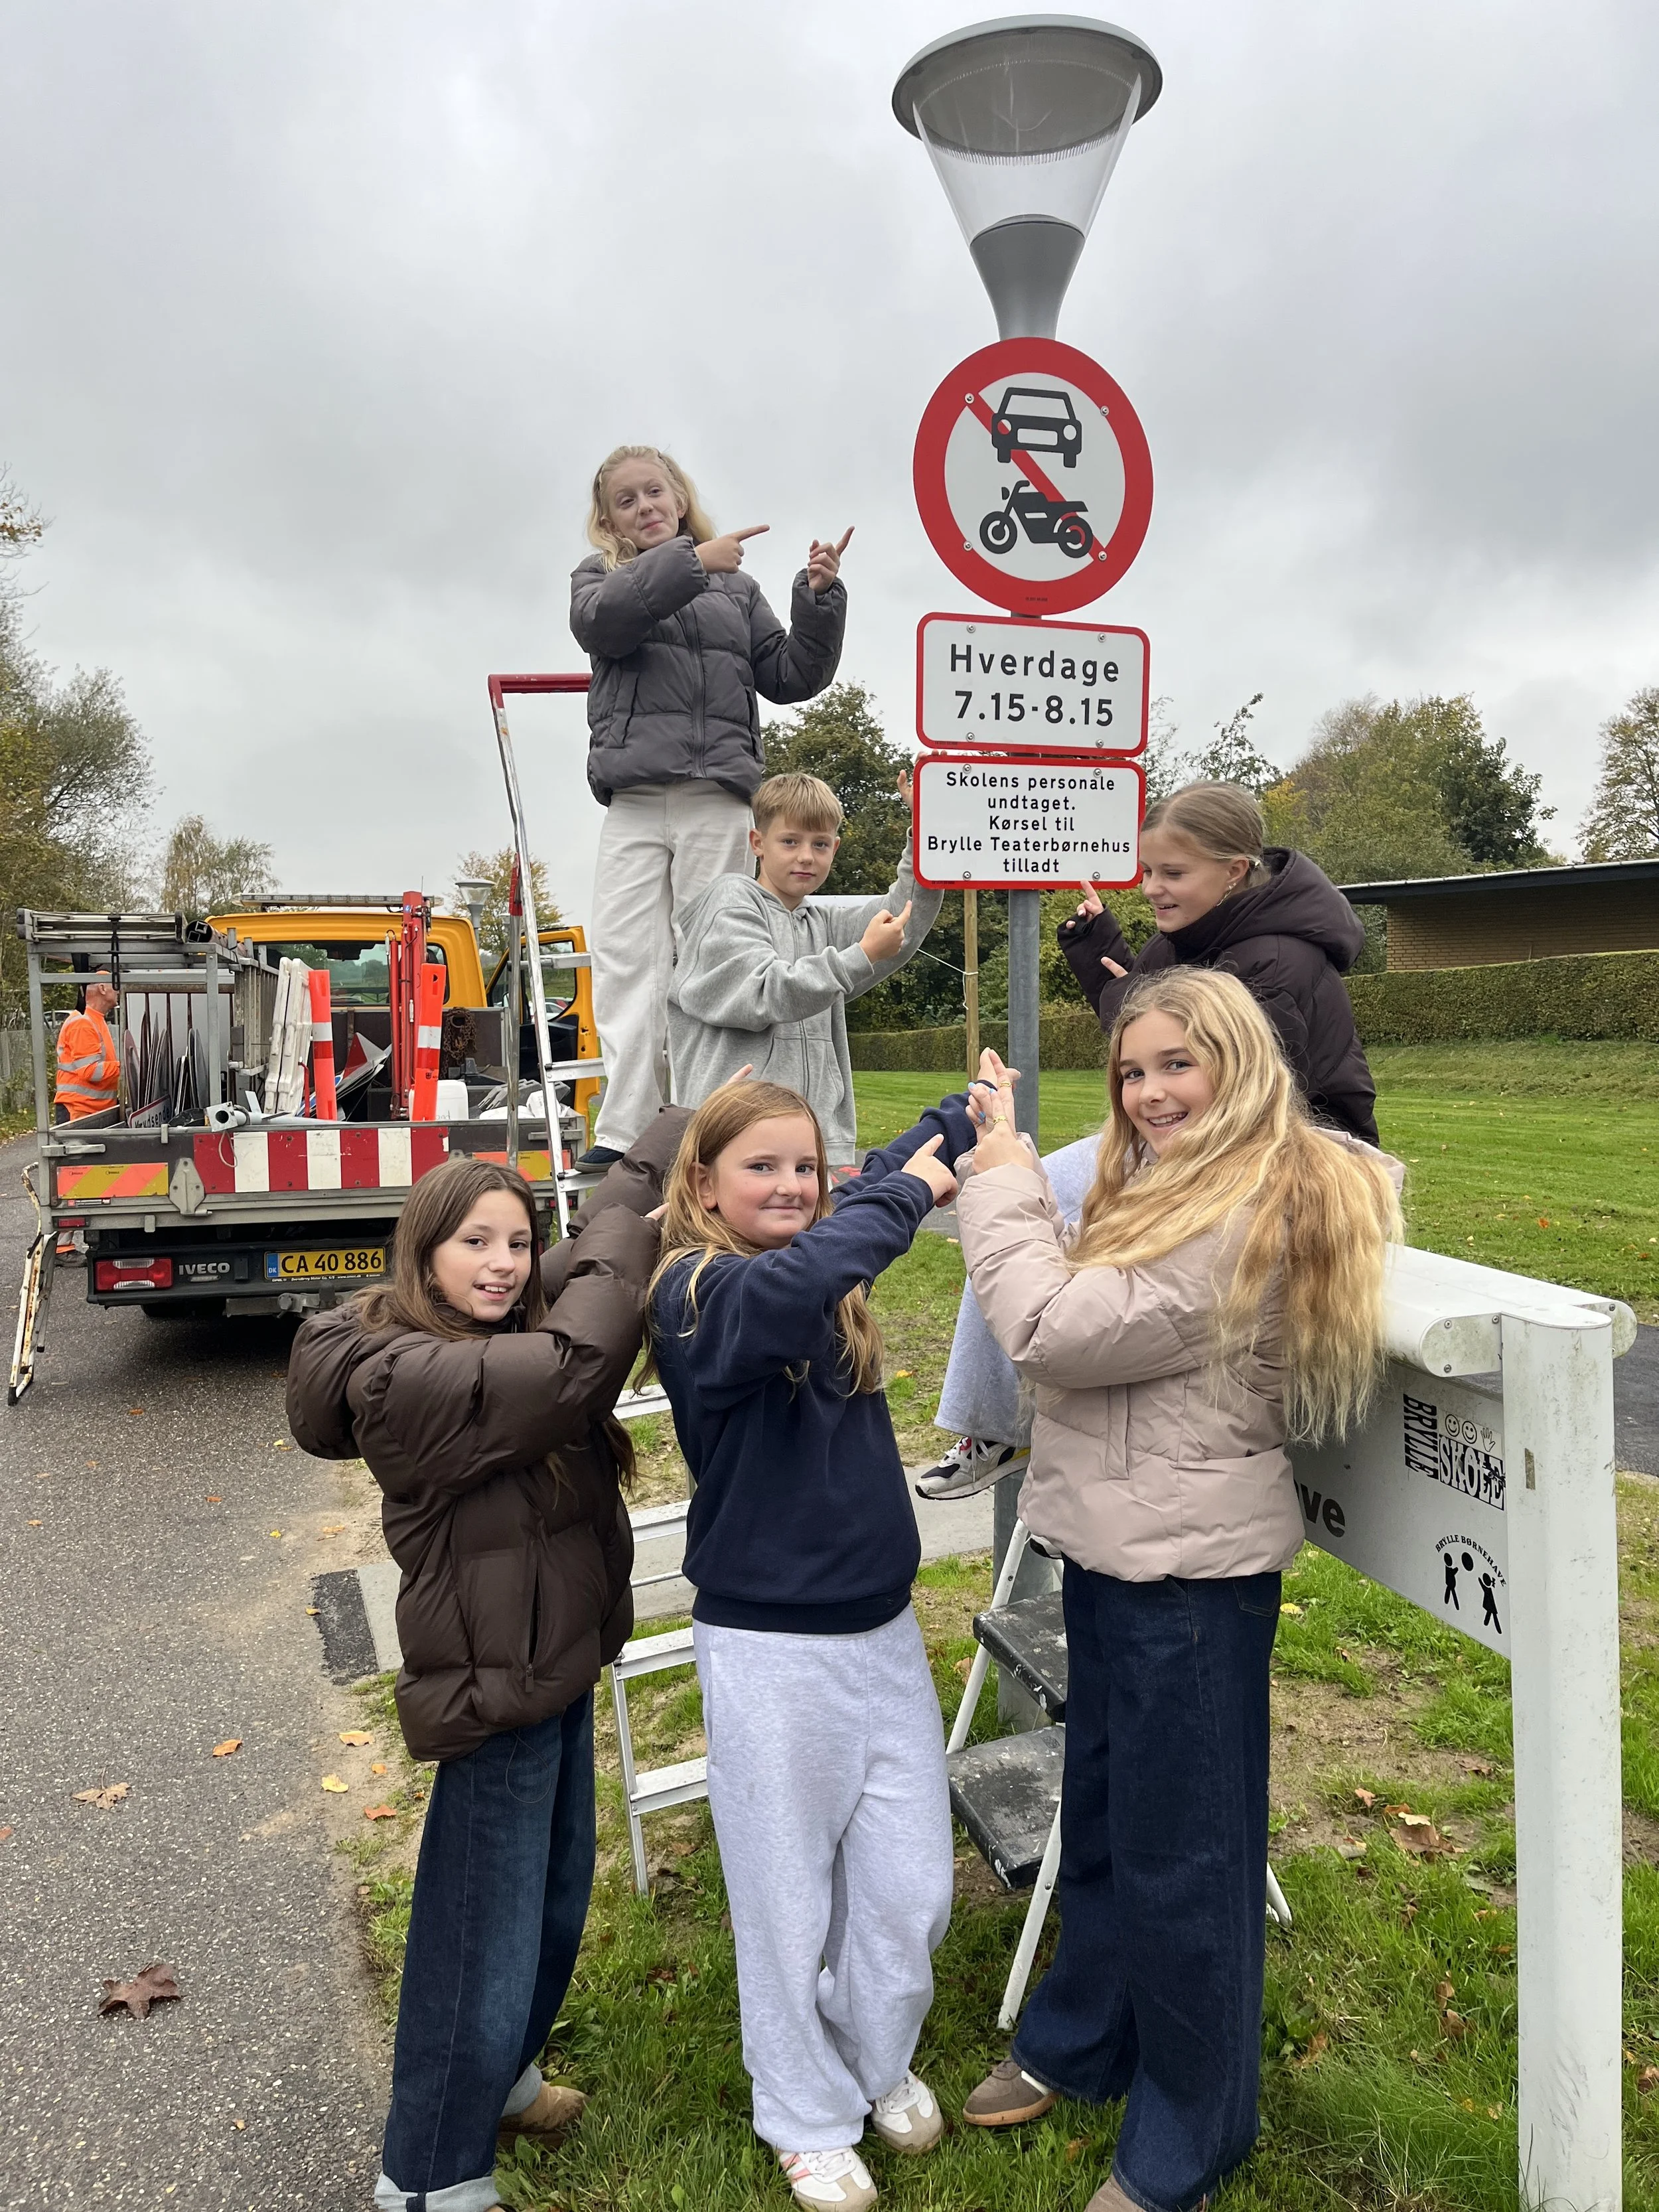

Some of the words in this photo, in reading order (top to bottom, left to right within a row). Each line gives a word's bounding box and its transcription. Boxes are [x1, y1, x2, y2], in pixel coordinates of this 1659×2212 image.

[951, 644, 1119, 686] Hverdage
[955, 691, 1113, 726] 7.15-8.15
[946, 772, 1019, 788] Skolens
[1029, 776, 1115, 790] personale
[987, 796, 1076, 812] undtaget.
[989, 816, 1047, 831] Kørsel
[1055, 817, 1074, 831] til
[928, 836, 982, 853] Brylle
[990, 837, 1130, 853] Teaterbørnehus
[1003, 858, 1060, 873] tilladt
[179, 1262, 230, 1276] IVECO
[281, 1255, 309, 1273] CA
[315, 1253, 338, 1272] 40
[344, 1250, 382, 1270] 886
[1403, 1394, 1439, 1480] BRYLLE
[1294, 1479, 1345, 1538] ve
[1435, 1534, 1459, 1552] BRYLLE
[1461, 1535, 1506, 1587] BØRNEHAVE
